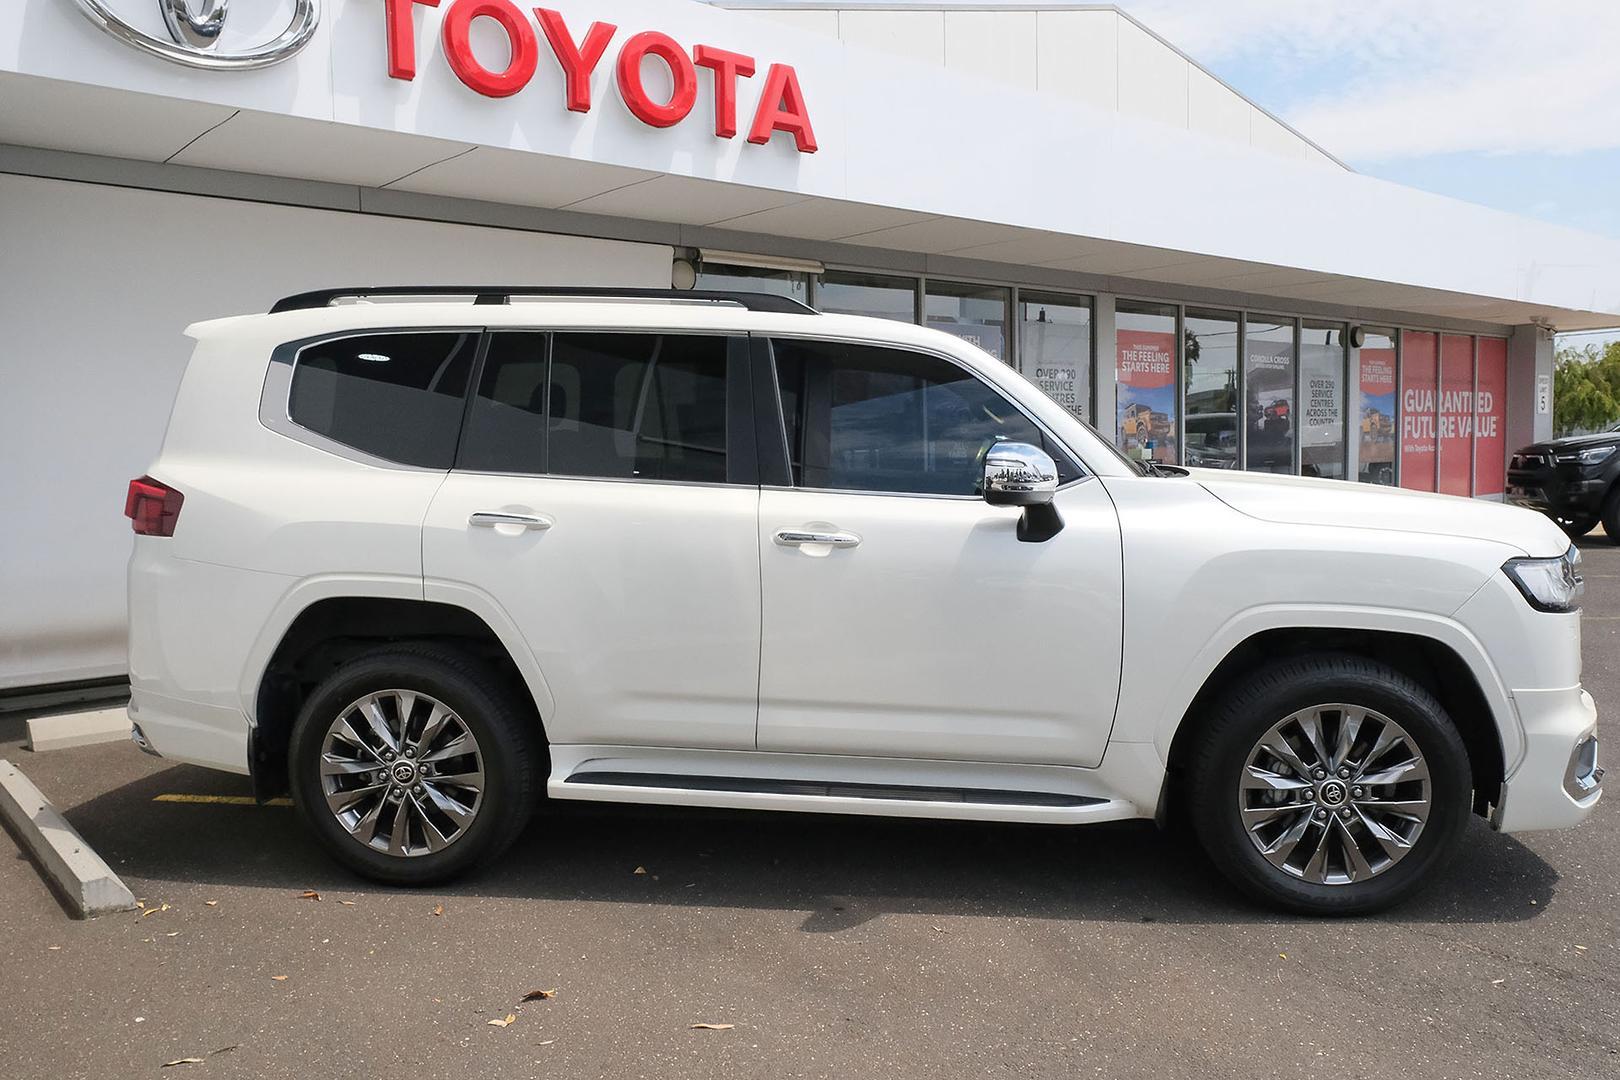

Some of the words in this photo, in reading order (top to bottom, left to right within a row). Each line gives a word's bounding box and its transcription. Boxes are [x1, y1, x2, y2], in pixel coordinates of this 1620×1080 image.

[385, 0, 818, 153] TOYOTA
[1122, 350, 1138, 361] THE
[1138, 351, 1170, 363] FEELING
[1273, 356, 1290, 365] CROSS
[1121, 361, 1150, 373] STARTS
[1151, 363, 1170, 374] HERE
[1036, 368, 1060, 379] OVER
[1040, 380, 1074, 391] SERVICE
[1309, 380, 1324, 389] OVER
[1311, 390, 1333, 398] SERVICE
[1310, 399, 1334, 408] CENTRES
[1306, 408, 1327, 417] ACROSS
[1328, 408, 1338, 417] THE
[1404, 416, 1455, 439] FUTURE
[1458, 416, 1497, 438] VALUE
